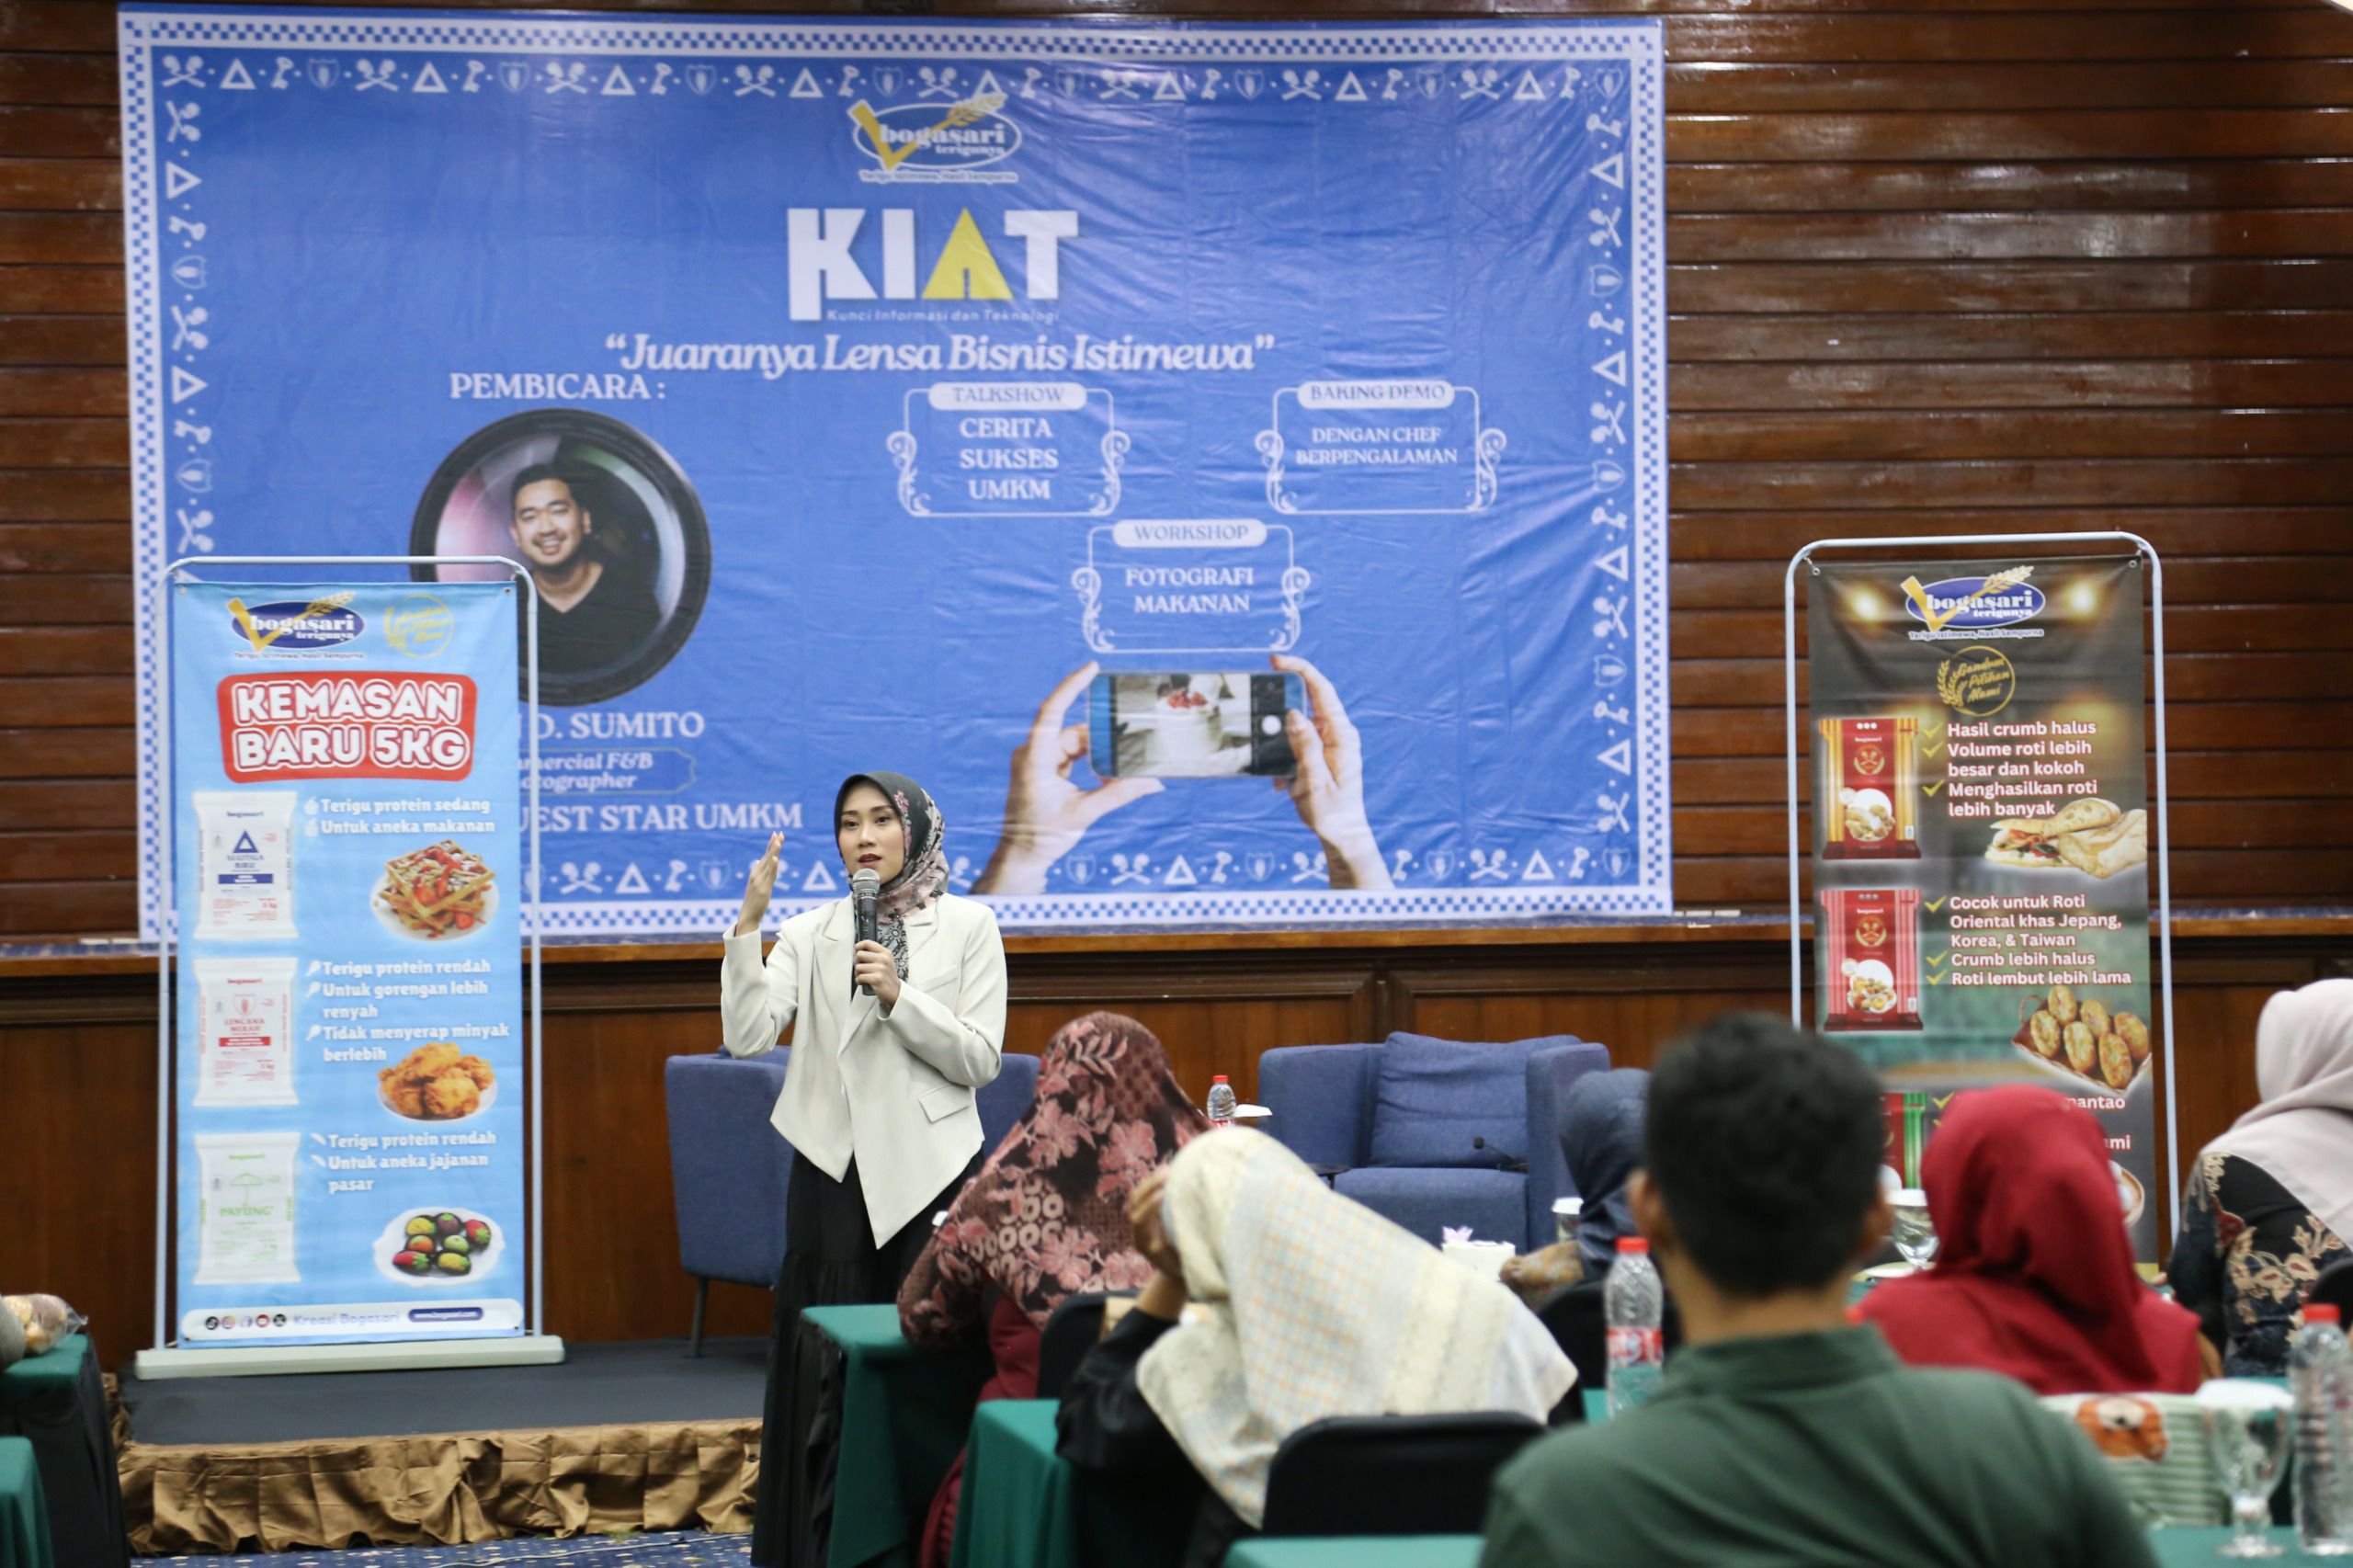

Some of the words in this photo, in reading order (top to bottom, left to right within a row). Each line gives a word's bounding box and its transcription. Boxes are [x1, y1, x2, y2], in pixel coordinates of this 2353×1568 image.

[881, 123, 1006, 149] bogasari
[788, 208, 1078, 321] KIAT
[827, 309, 871, 321] Kunci
[875, 309, 949, 322] Informasi
[951, 309, 980, 322] dan
[984, 309, 1059, 324] Teknologi
[605, 333, 818, 380] “Juaranya
[823, 334, 942, 370] Lensa
[949, 334, 1067, 370] Bisnis
[1073, 334, 1276, 370] Istimewa”
[449, 372, 652, 399] PEMBICARA
[952, 386, 1065, 403] TALKSHOW
[1311, 384, 1383, 401] BAKING
[1389, 383, 1446, 400] DEMO
[959, 417, 1054, 438] CERITA
[1312, 427, 1390, 443] DENGAN
[1392, 426, 1442, 442] CHEF
[960, 448, 1059, 470] SUKSES
[1296, 448, 1458, 465] BERPENGALAMAN
[968, 479, 1051, 500] UMKM
[1134, 525, 1249, 540] WORKSHOP
[1125, 566, 1255, 586] FOTOGRAFI
[1134, 595, 1250, 613] MAKANAN
[1927, 590, 2033, 614] bogasari
[1973, 608, 2033, 619] terigunya
[250, 614, 355, 636] bogasari
[234, 681, 461, 723] KEMASAN
[570, 711, 706, 739] SUMITO
[1948, 722, 1989, 737] Hasil
[1993, 722, 2047, 736] crumb
[2052, 720, 2097, 735] halus
[234, 729, 362, 770] BARU
[372, 728, 470, 768] 5KG
[1948, 743, 2011, 757] Volume
[2016, 741, 2045, 756] roti
[2050, 740, 2092, 755] lebih
[606, 752, 654, 769] F&B
[1948, 762, 1995, 777] besar
[1998, 761, 2029, 776] dan
[2034, 760, 2085, 775] kokoh
[1949, 780, 2063, 800] Menghasilkan
[2067, 779, 2097, 794] roti
[321, 798, 370, 814] Terigu
[375, 798, 432, 815] protein
[435, 798, 491, 814] sedang
[1949, 802, 1990, 816] lebih
[1995, 801, 2055, 818] banyak
[599, 803, 689, 832] STAR
[695, 802, 803, 830] UMKM
[322, 820, 369, 834] Untuk
[372, 819, 420, 834] aneka
[423, 819, 495, 833] makanan
[1949, 895, 1999, 909] Cocok
[2003, 894, 2049, 909] untuk
[2052, 894, 2086, 908] Roti
[1950, 914, 2015, 928] Oriental
[2018, 914, 2055, 927] khas
[2059, 914, 2122, 930] Jepang,
[1950, 934, 2001, 949] Korea,
[2005, 934, 2017, 947] &
[2019, 933, 2075, 947] Taiwan
[1951, 952, 2005, 966] Crumb
[2008, 952, 2049, 965] lebih
[2052, 951, 2096, 965] halus
[323, 961, 372, 978] Terigu
[376, 960, 433, 977] protein
[437, 959, 492, 973] rendah
[1951, 971, 1984, 985] Roti
[1987, 971, 2045, 984] lembut
[2049, 971, 2088, 984] lebih
[2093, 971, 2131, 983] lama
[323, 982, 371, 996] Untuk
[374, 983, 449, 999] gorengan
[450, 980, 489, 994] lebih
[324, 1004, 379, 1021] renyah
[324, 1025, 367, 1040] Tidak
[370, 1026, 449, 1041] menyerap
[452, 1023, 510, 1040] minyak
[324, 1047, 387, 1062] berlebih
[328, 1133, 378, 1150] Terigu
[381, 1132, 439, 1150] protein
[442, 1131, 496, 1145] rendah
[328, 1155, 377, 1170] Untuk
[380, 1154, 426, 1169] aneka
[426, 1153, 490, 1171] jajanan
[328, 1178, 375, 1195] pasar
